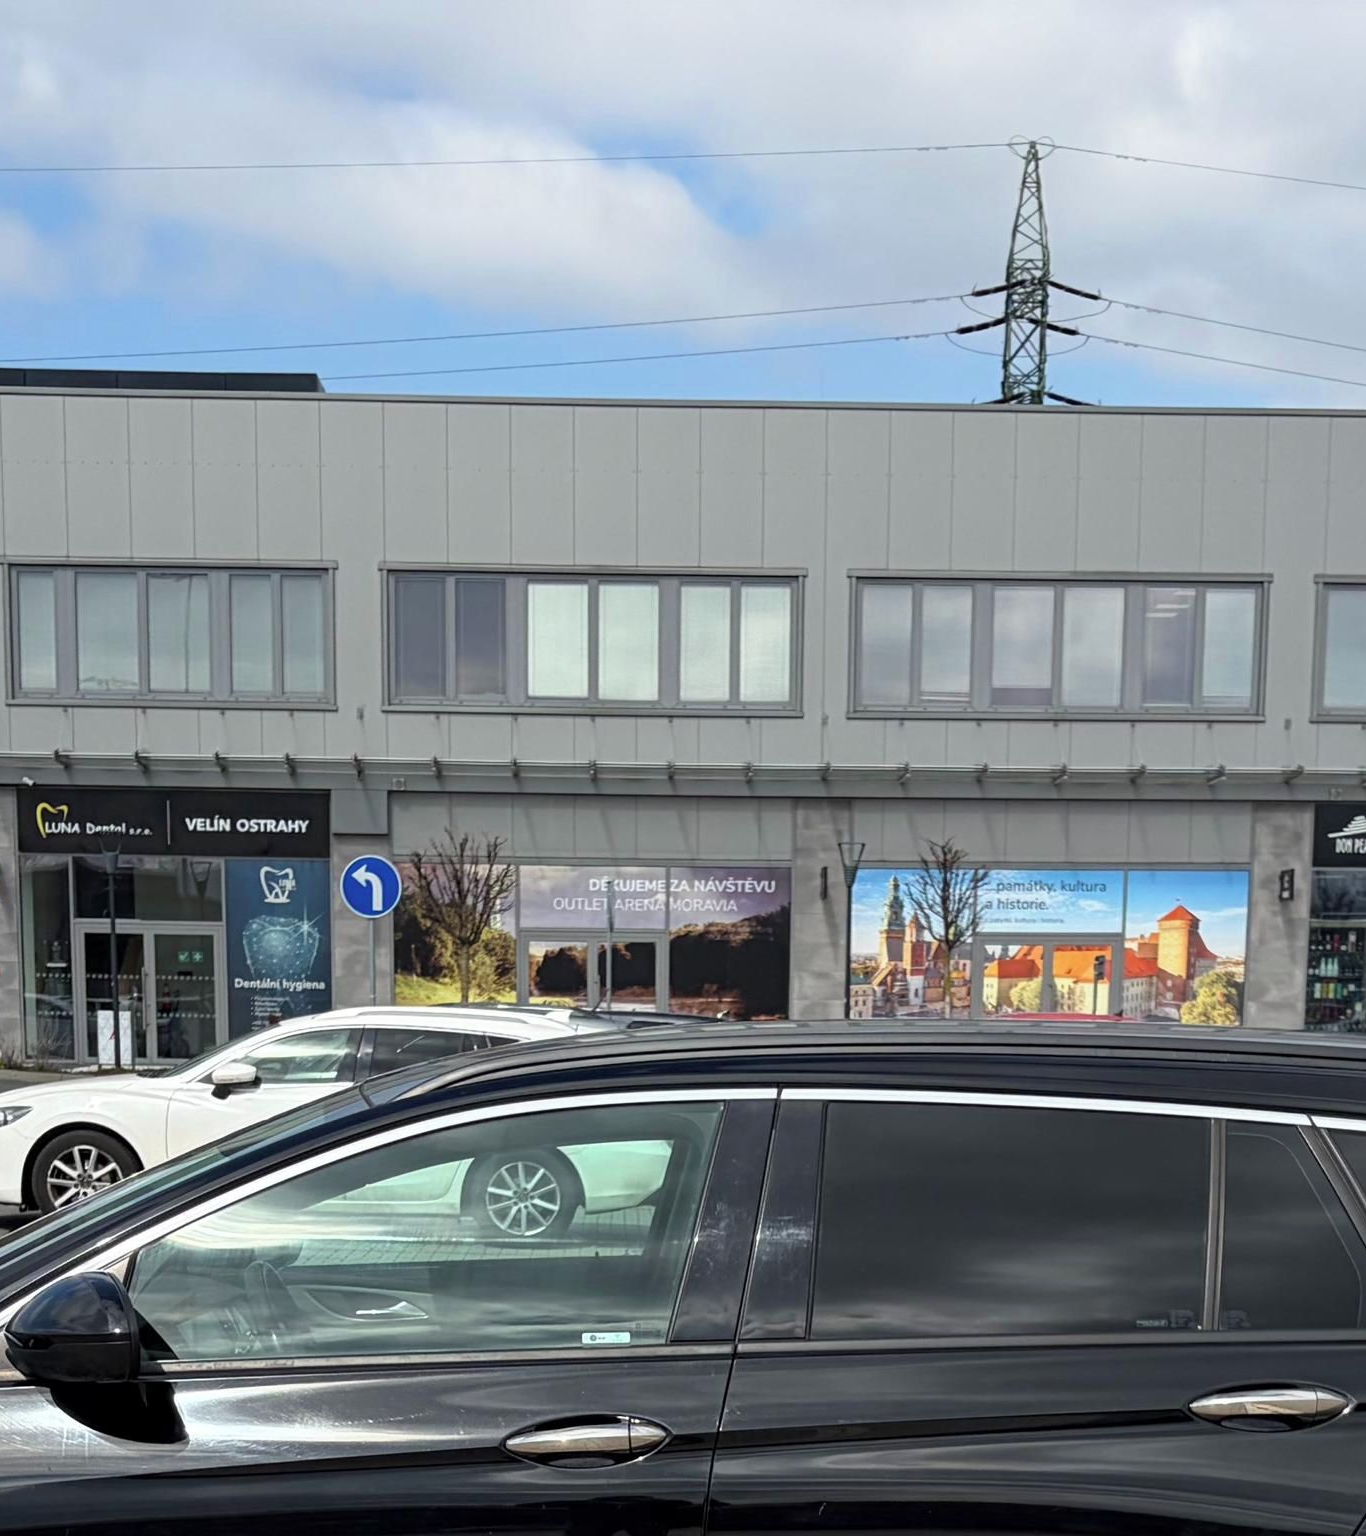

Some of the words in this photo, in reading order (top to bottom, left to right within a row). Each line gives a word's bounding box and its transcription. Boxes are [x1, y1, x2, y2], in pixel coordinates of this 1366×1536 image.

[45, 822, 81, 834] LUNA
[185, 815, 231, 832] VELÍN
[236, 818, 310, 834] OSTRAHY
[670, 880, 691, 892] ZA
[694, 876, 776, 893] NÁVŠTĚVU
[1060, 880, 1107, 892] kultura
[614, 898, 666, 911] ARENA
[669, 897, 739, 912] MORAVIA
[997, 898, 1049, 910] historie.
[235, 977, 281, 990] Dentální
[283, 978, 326, 991] hygiena
